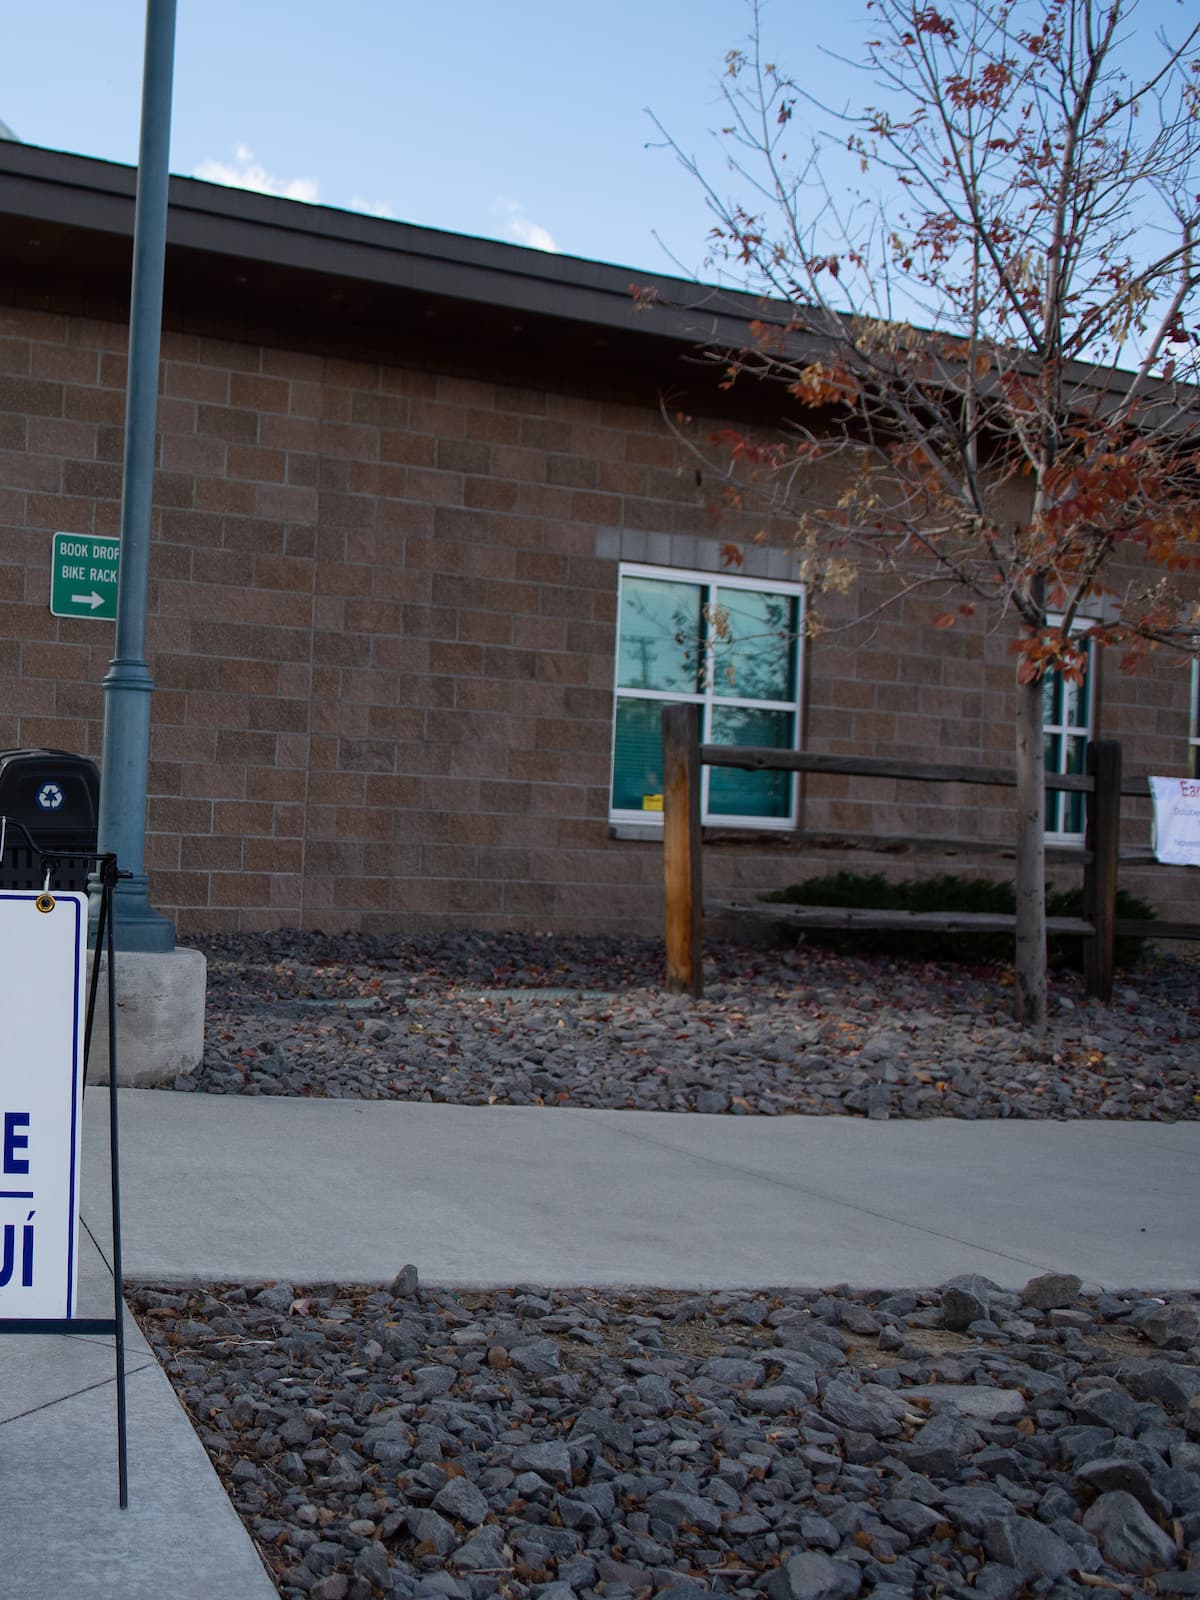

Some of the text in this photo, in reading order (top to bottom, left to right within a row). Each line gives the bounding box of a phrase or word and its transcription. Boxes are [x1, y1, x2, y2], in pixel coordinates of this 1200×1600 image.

[60, 542, 88, 557] BOOK
[62, 565, 117, 583] BIKE RACK
